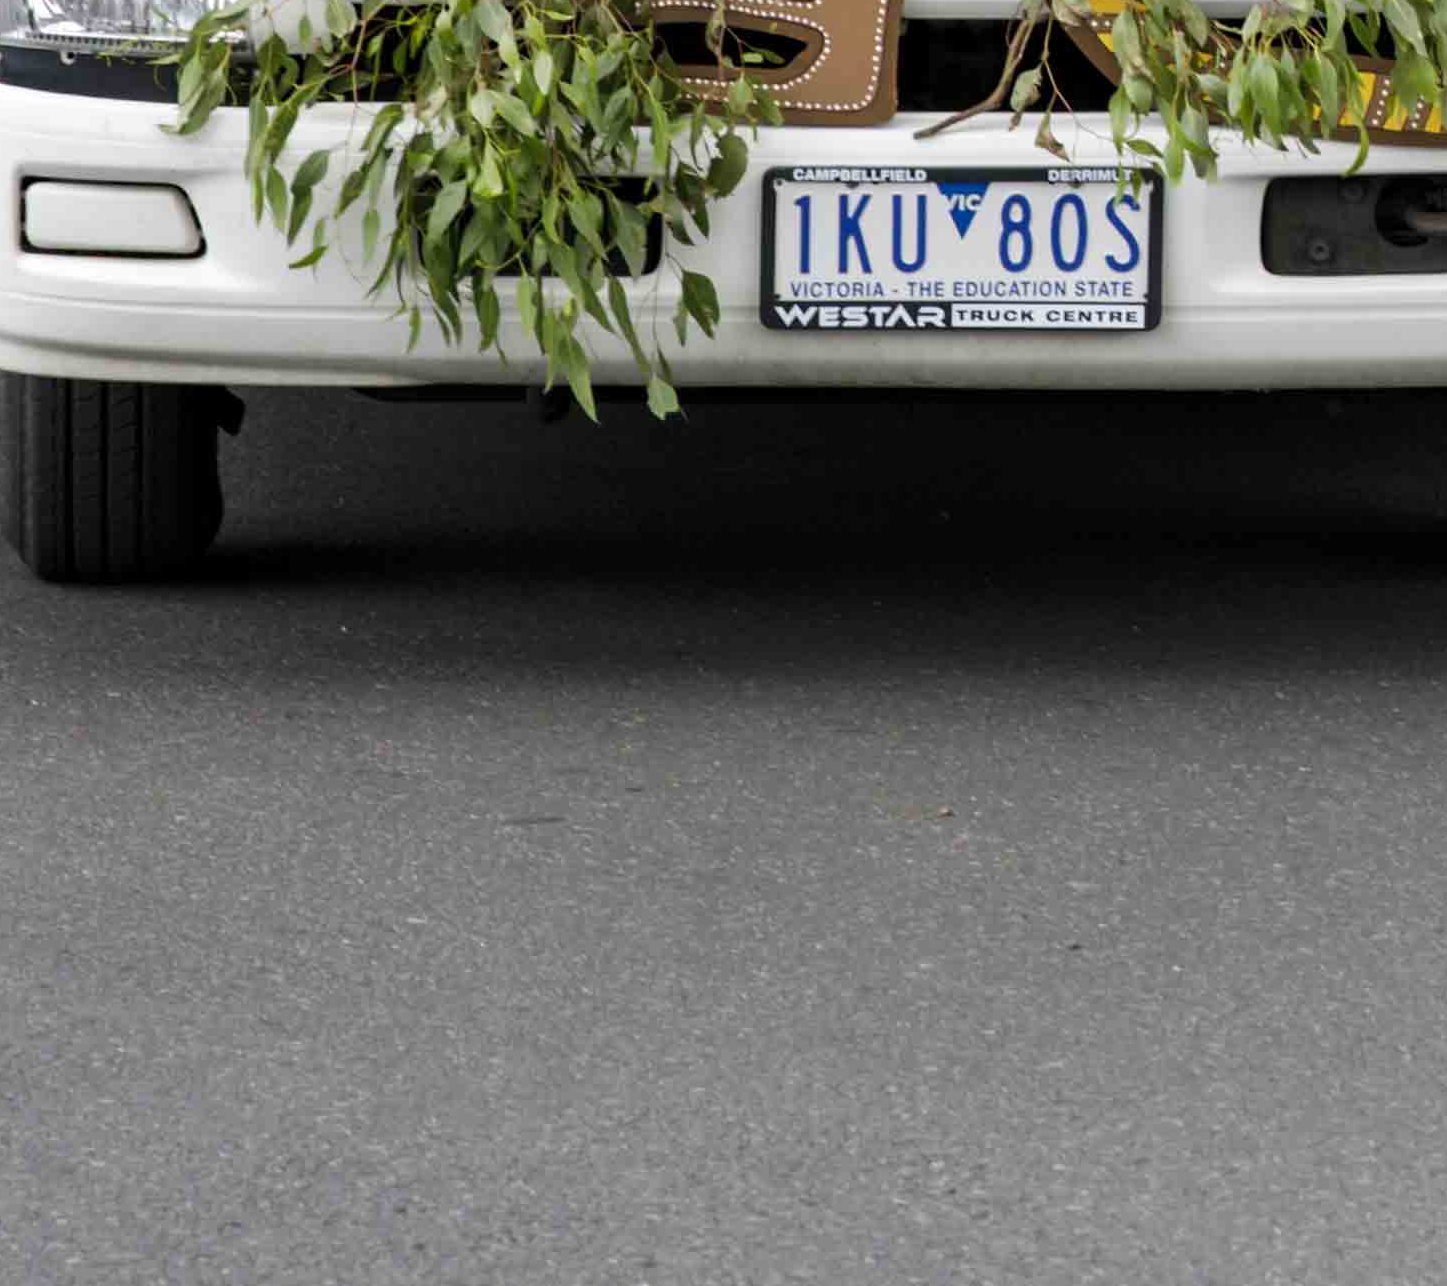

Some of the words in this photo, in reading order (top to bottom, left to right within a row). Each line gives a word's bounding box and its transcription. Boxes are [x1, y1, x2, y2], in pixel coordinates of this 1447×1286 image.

[792, 168, 927, 181] CAMPBELLFIELD
[946, 194, 981, 211] VIC
[794, 194, 927, 273] 1KU
[791, 281, 884, 298] VICTORIA
[908, 281, 944, 297] THE
[954, 281, 1066, 297] EDUCATION
[1075, 281, 1133, 297] STATE
[775, 304, 946, 328] WESTAR
[957, 309, 1034, 323] TRUCK
[1046, 310, 1138, 323] CENTRE
